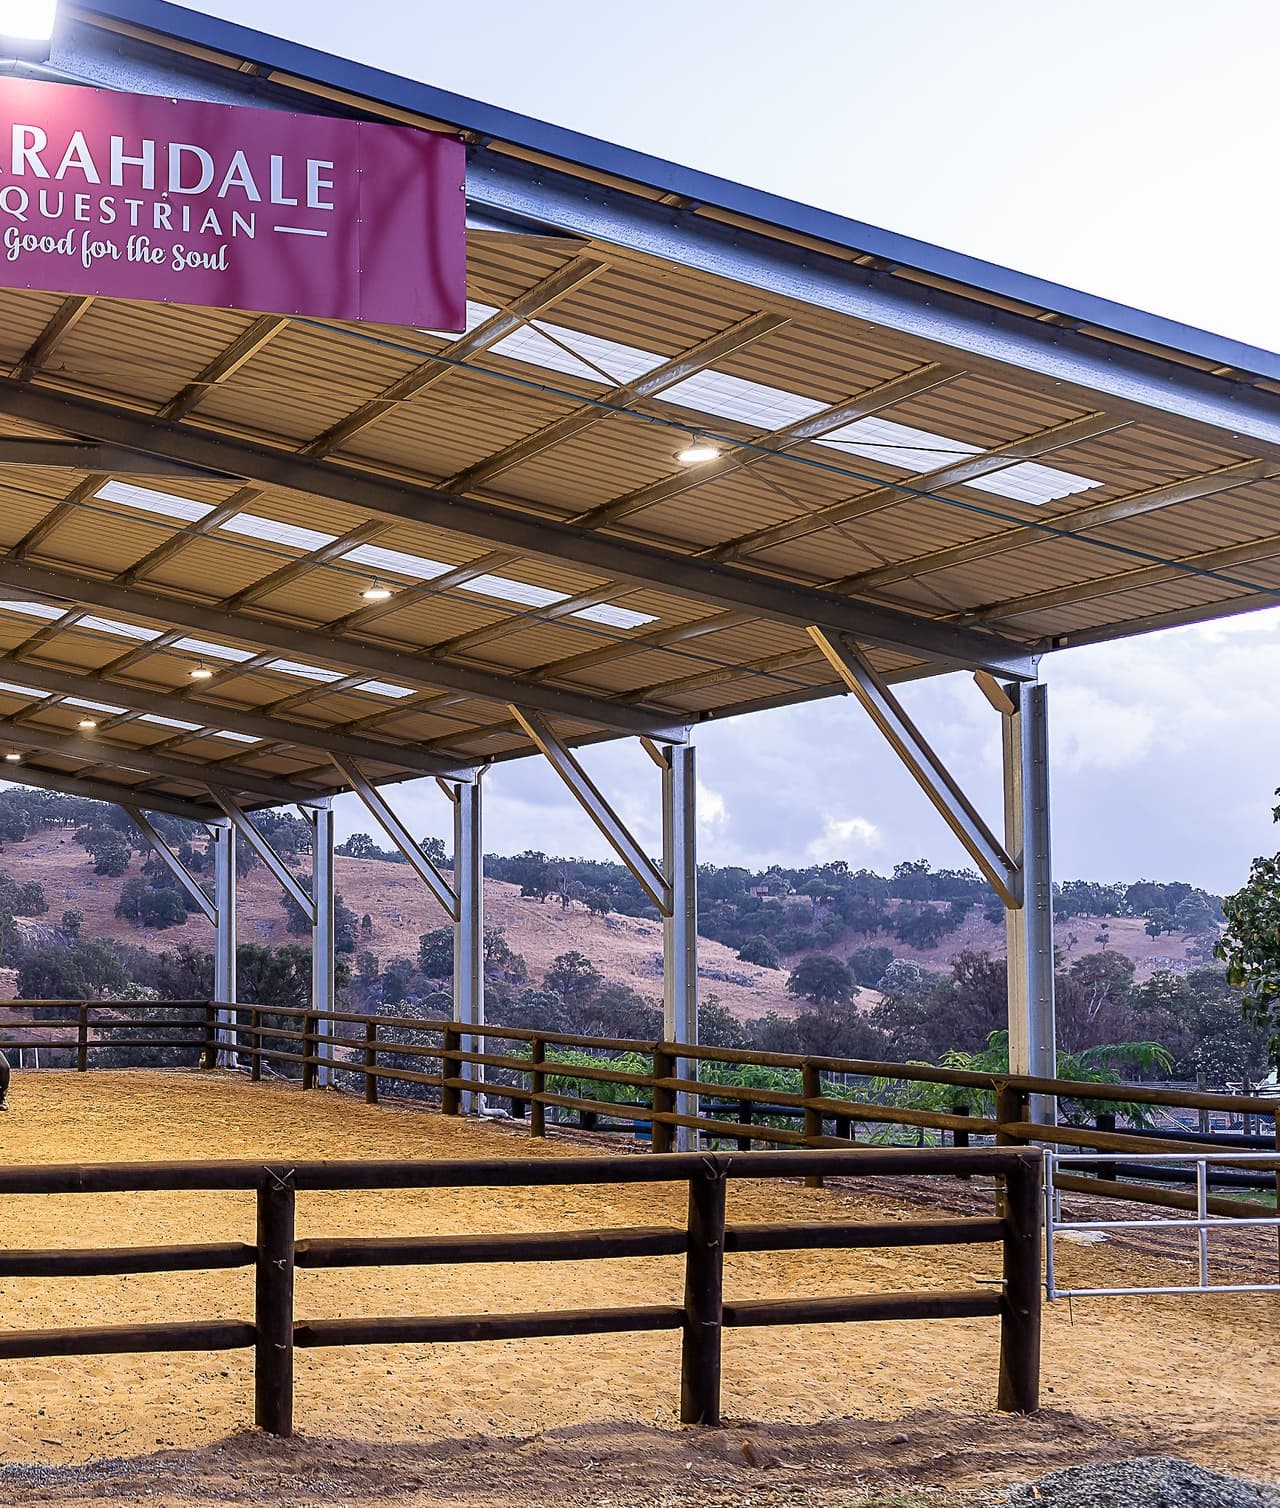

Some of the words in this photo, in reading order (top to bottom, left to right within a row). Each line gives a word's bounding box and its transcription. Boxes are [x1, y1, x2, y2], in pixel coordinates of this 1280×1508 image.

[4, 227, 76, 261] Good
[81, 230, 121, 269] for
[126, 235, 166, 264] the
[171, 244, 230, 272] Soul
